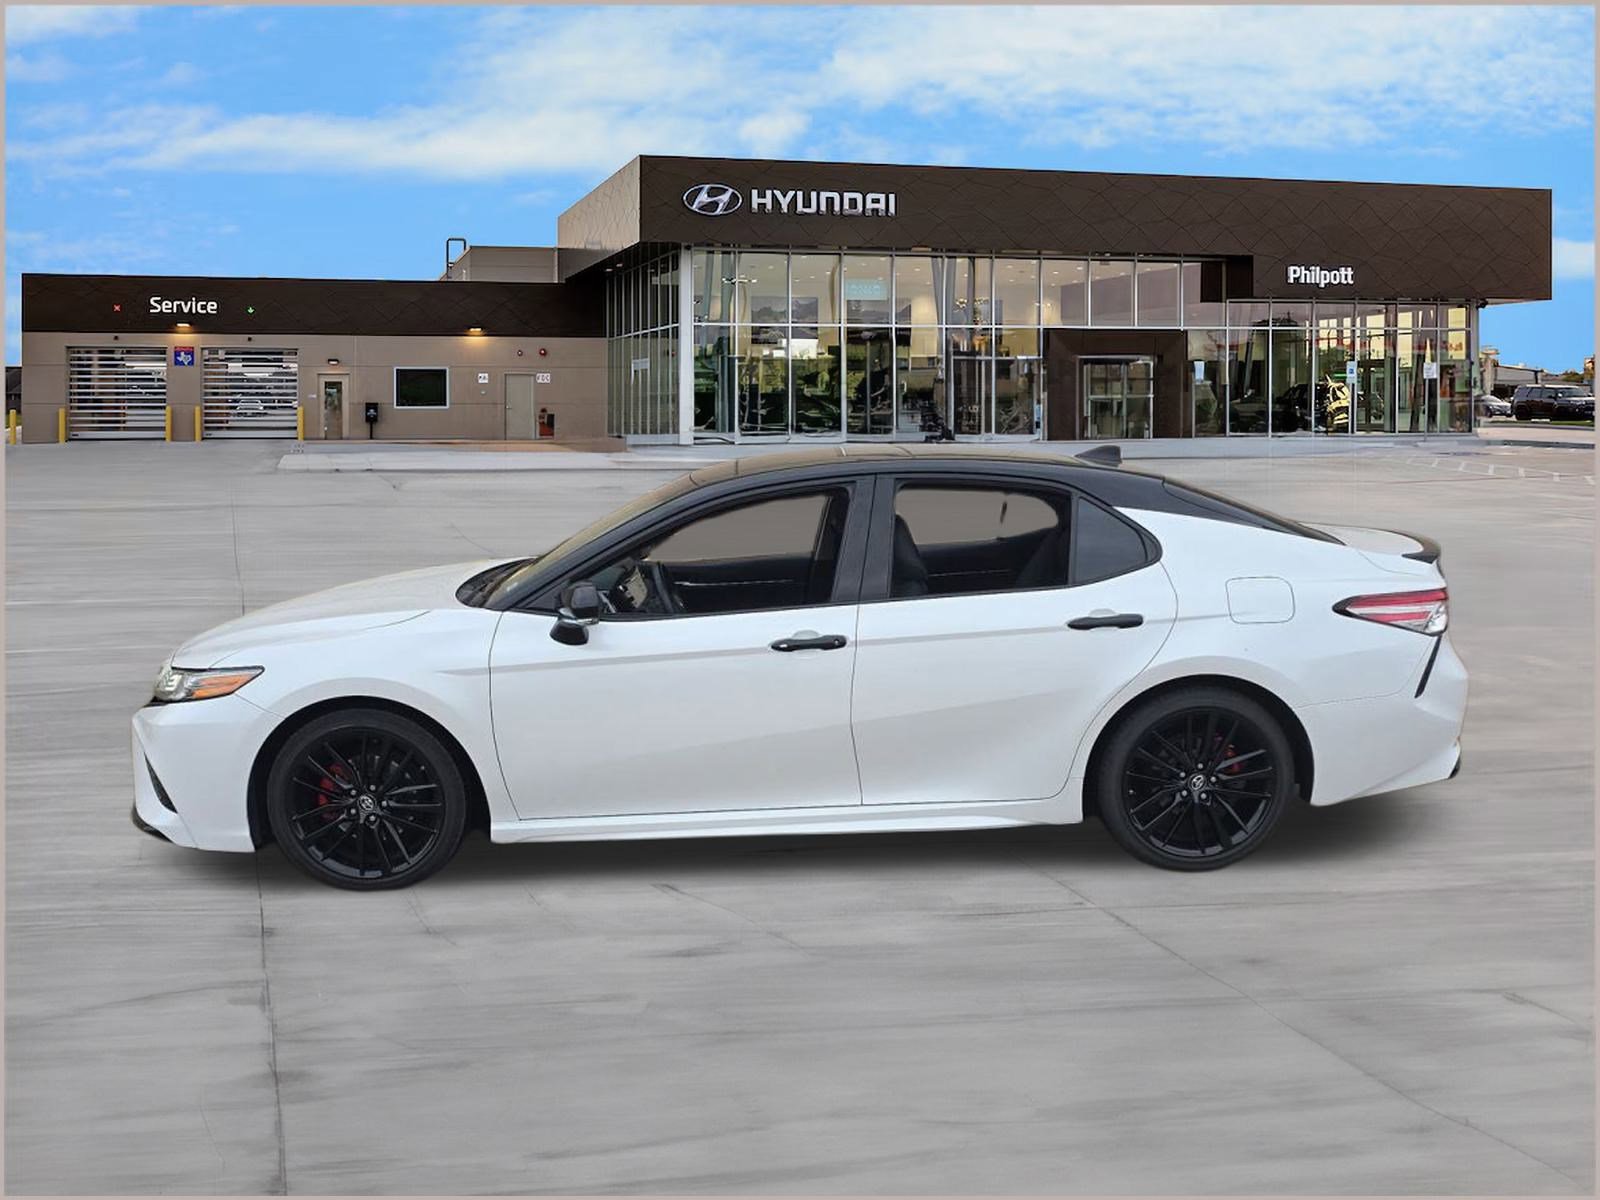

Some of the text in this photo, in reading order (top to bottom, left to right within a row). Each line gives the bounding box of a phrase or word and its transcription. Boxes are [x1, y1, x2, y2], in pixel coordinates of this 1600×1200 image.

[751, 189, 896, 216] HYUNDAI
[1287, 265, 1355, 288] Philpott
[149, 296, 218, 314] Service
